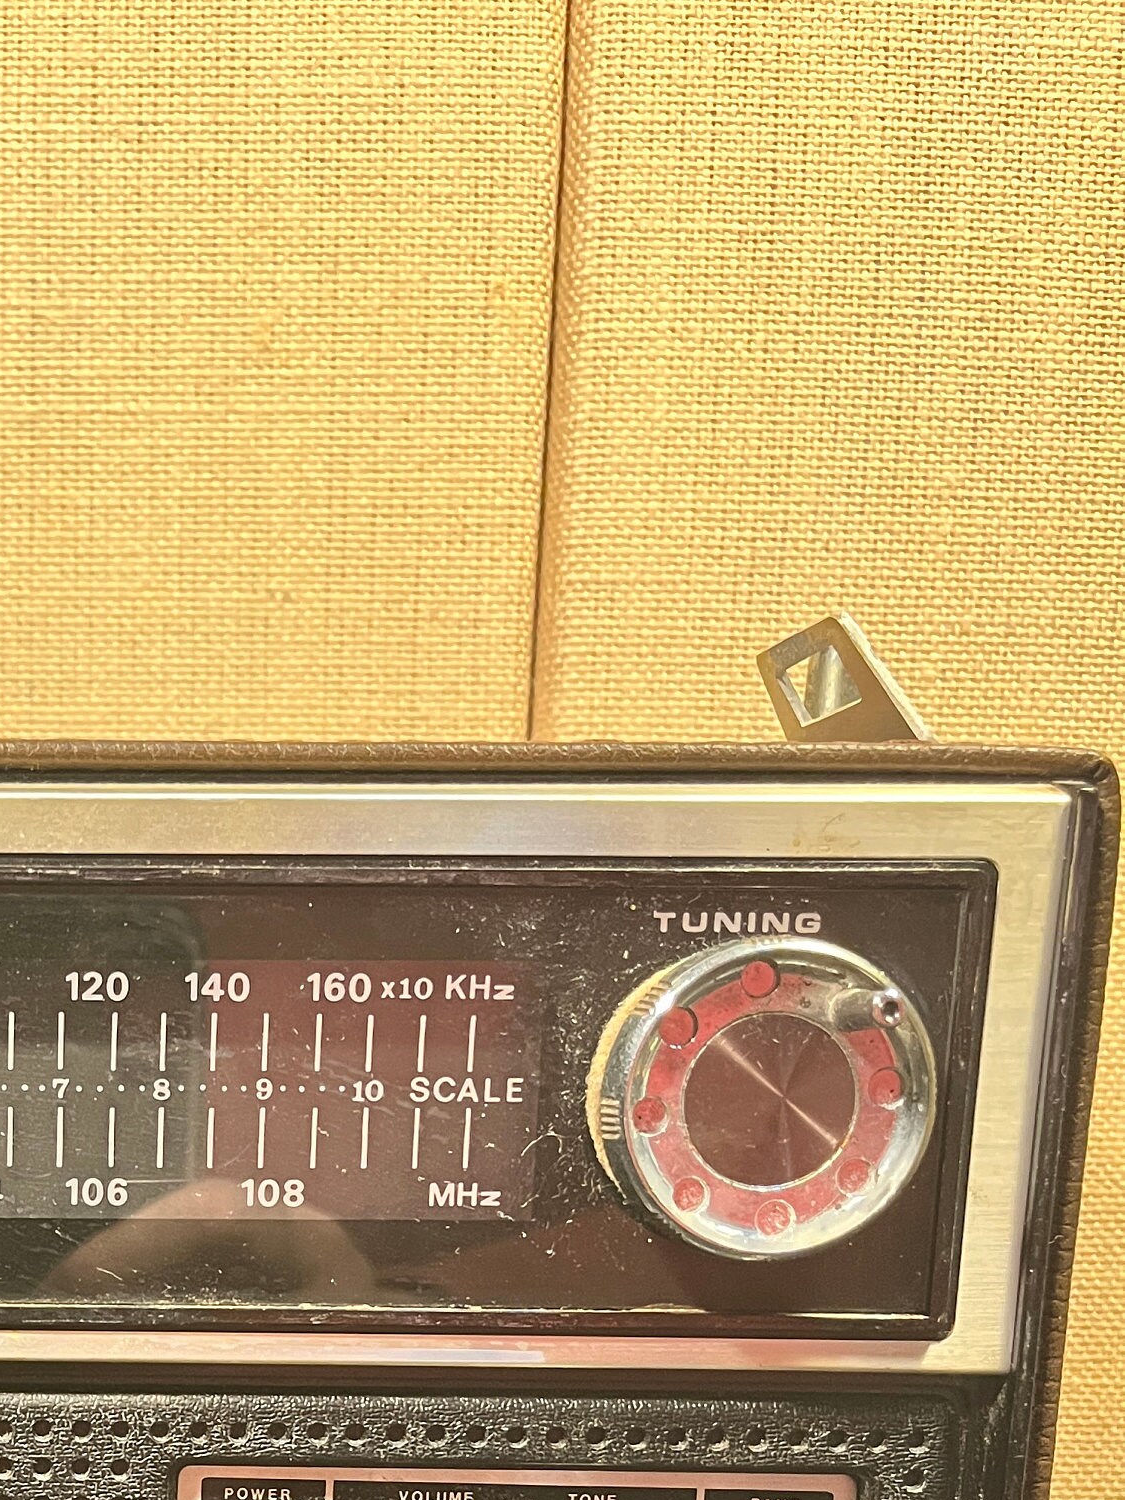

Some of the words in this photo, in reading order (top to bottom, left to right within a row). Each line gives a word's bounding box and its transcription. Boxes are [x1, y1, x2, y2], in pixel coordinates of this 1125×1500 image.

[653, 910, 822, 934] TUNING
[65, 971, 129, 1002] 120
[184, 972, 251, 1002] 140
[306, 972, 372, 1003] 160
[445, 974, 515, 1001] KHz
[52, 1078, 70, 1099] 7
[152, 1079, 171, 1100] 8
[255, 1078, 273, 1100] 9
[352, 1079, 384, 1102] 10
[409, 1077, 524, 1103] SCALE
[65, 1177, 128, 1206] 106
[240, 1178, 305, 1207] 108
[428, 1182, 501, 1207] MHz
[224, 1487, 291, 1500] POWER
